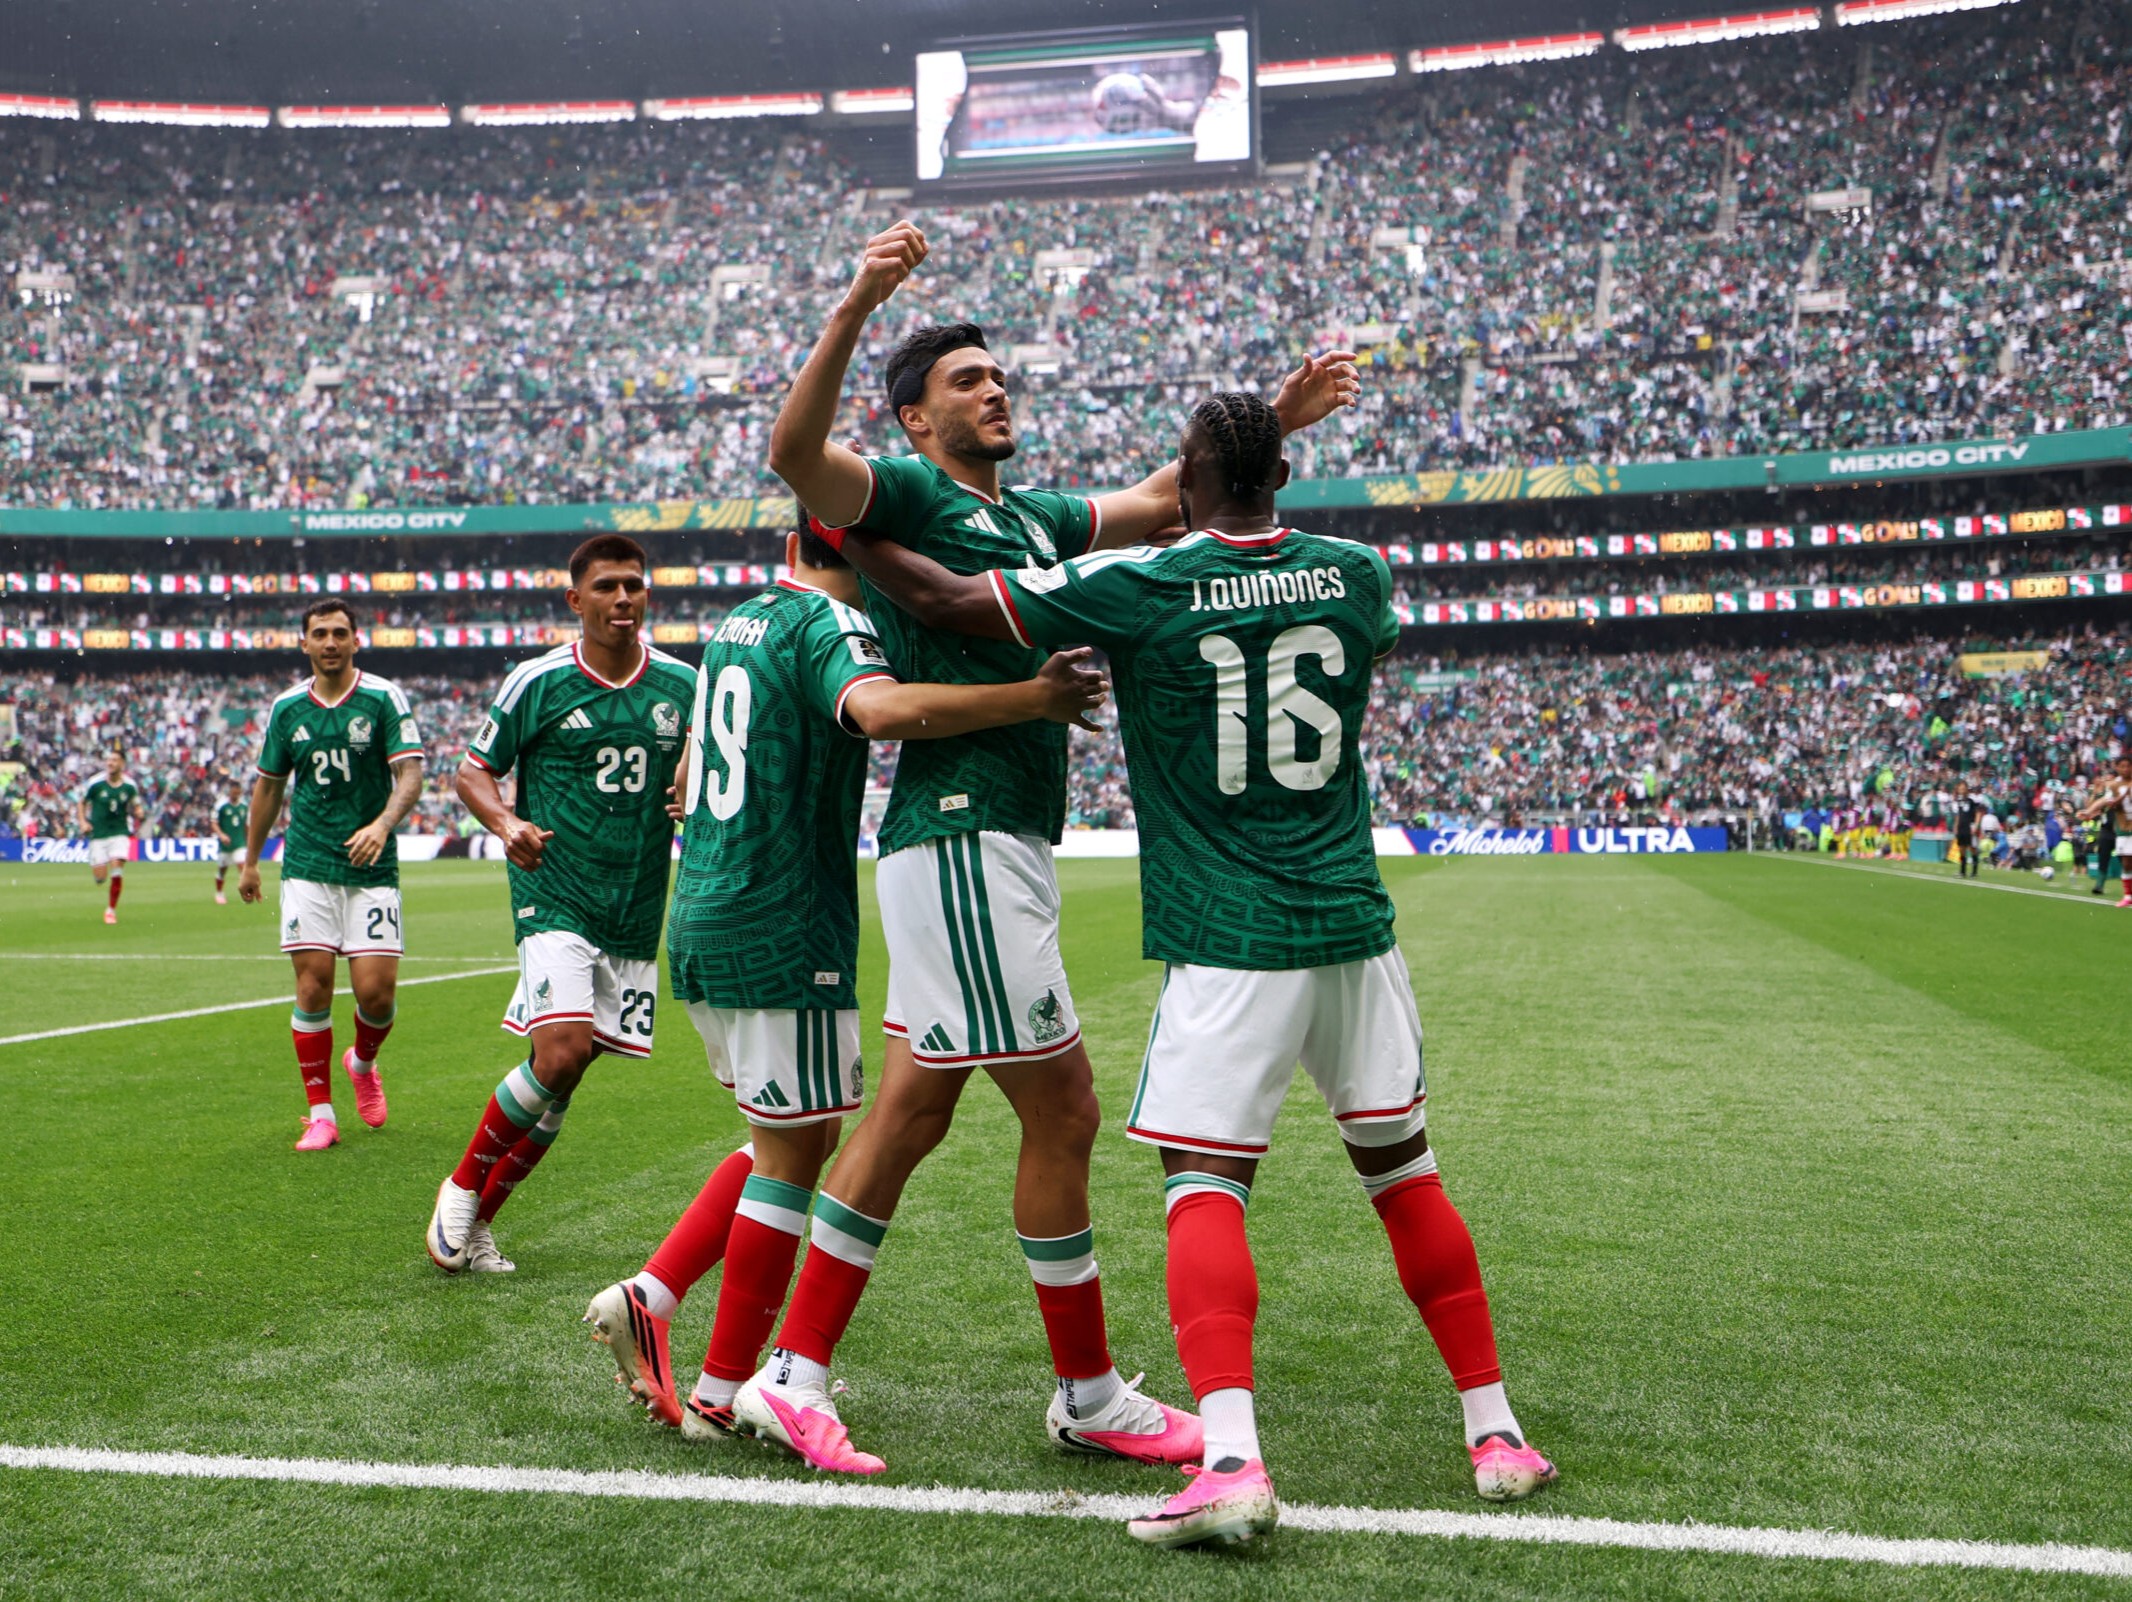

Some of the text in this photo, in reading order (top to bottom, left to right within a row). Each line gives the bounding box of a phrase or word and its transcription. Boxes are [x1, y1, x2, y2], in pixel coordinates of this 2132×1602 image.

[1829, 442, 2030, 474] MEXICO CITY
[305, 512, 467, 530] MEXICO CITY
[1190, 566, 1345, 612] J.QUIÑONES
[1199, 624, 1345, 795] 16
[685, 663, 751, 821] 19
[312, 748, 351, 785] 24
[596, 746, 648, 793] 23
[22, 837, 219, 863] Mich ULTR
[1429, 827, 1695, 855] Michelob ULTRA
[367, 907, 399, 940] 24
[620, 988, 656, 1037] 23
